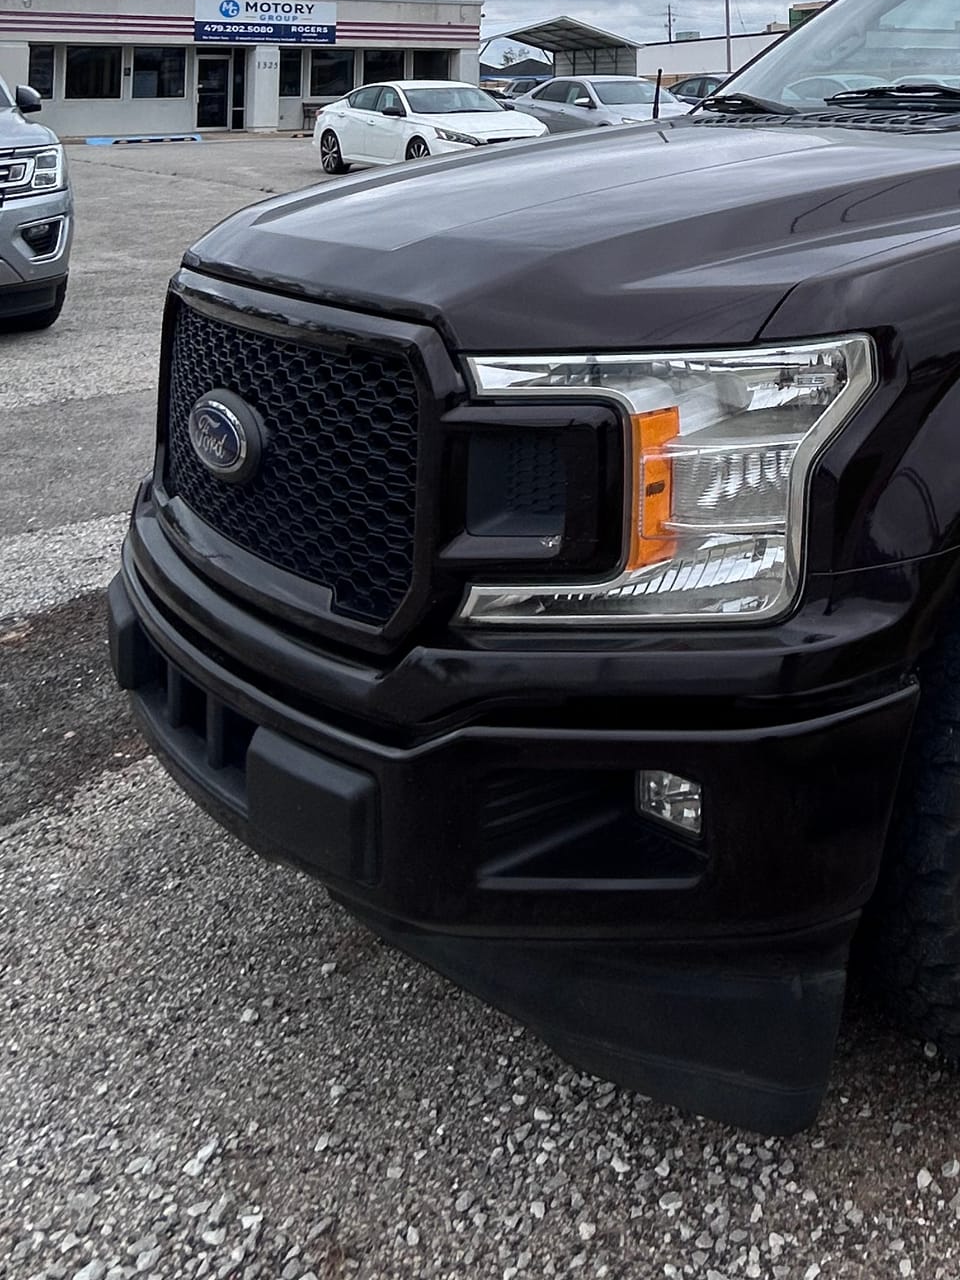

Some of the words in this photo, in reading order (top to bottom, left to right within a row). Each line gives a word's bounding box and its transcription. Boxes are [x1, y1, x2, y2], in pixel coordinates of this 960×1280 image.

[245, 1, 315, 14] MOTORY
[259, 14, 299, 22] GROUP
[203, 24, 274, 34] 479.202.5080
[291, 25, 328, 34] ROGERS
[196, 414, 228, 460] Ford
